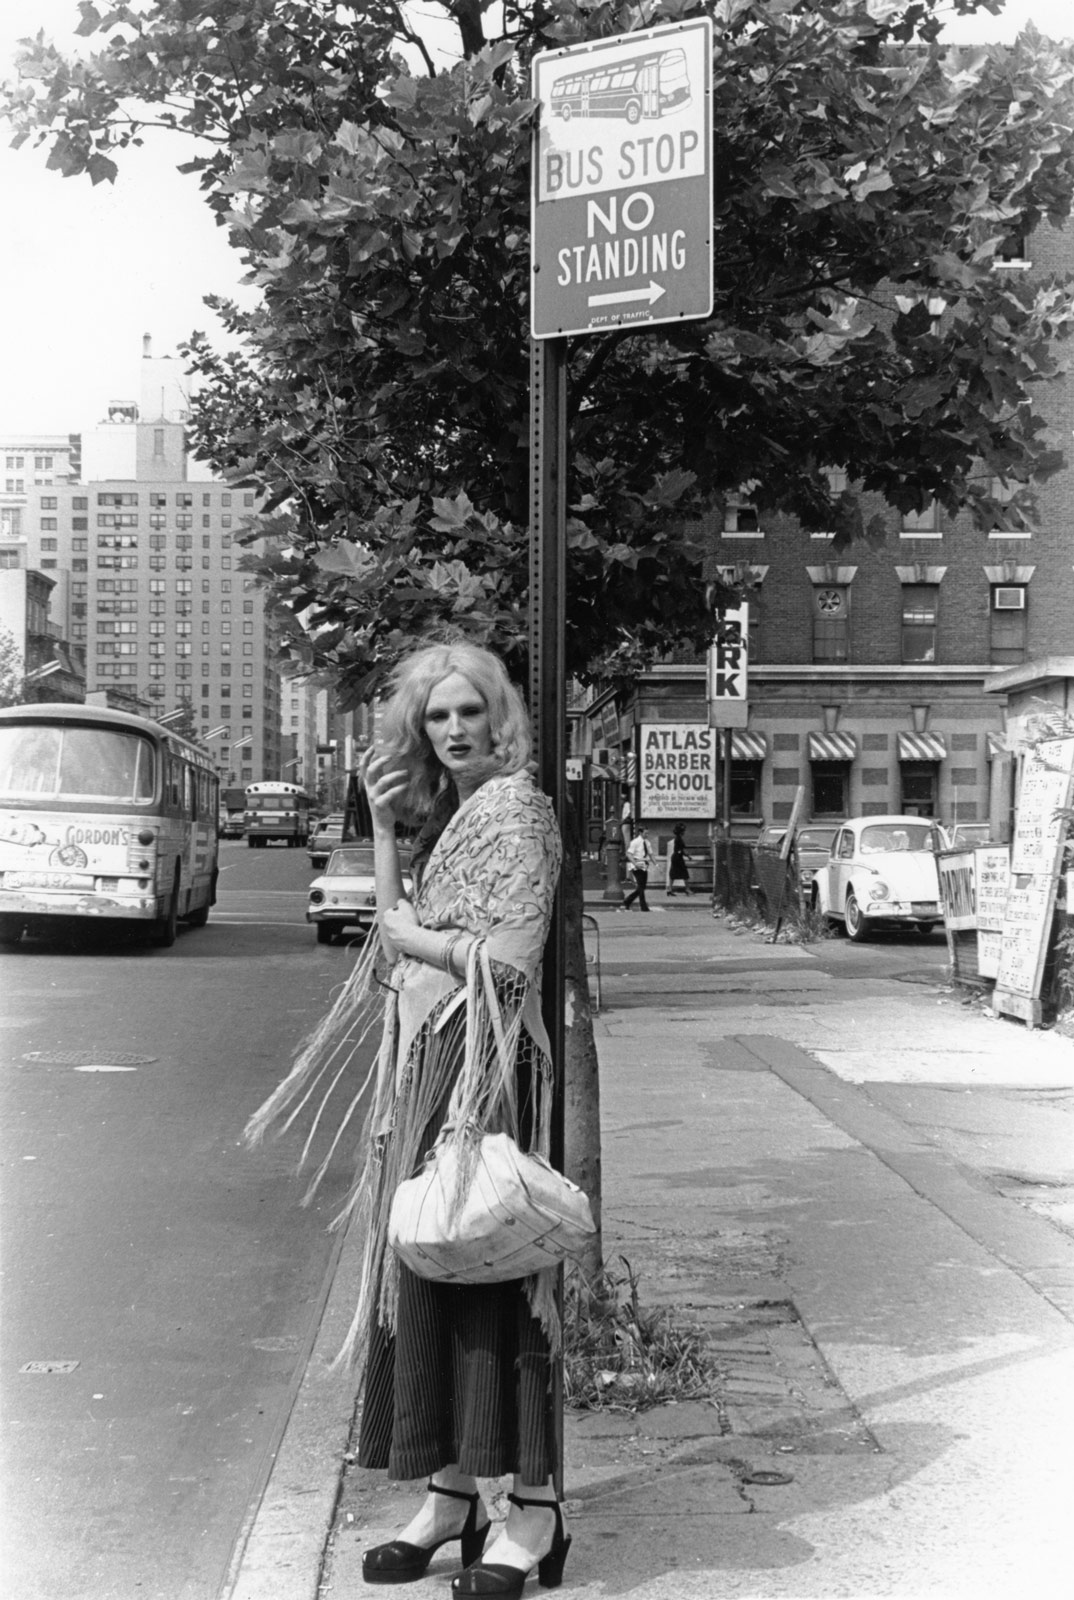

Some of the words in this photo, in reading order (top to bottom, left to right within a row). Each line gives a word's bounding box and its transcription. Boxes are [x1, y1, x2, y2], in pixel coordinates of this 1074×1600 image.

[546, 146, 604, 193] BUS
[618, 130, 698, 180] STOP
[588, 192, 655, 238] NO
[557, 230, 687, 286] STANDING
[623, 310, 650, 320] TRAFFIC
[646, 731, 711, 750] ATLAS
[645, 753, 711, 770] BARBER
[645, 773, 713, 791] SCHOOL
[66, 826, 129, 846] GORDON'S
